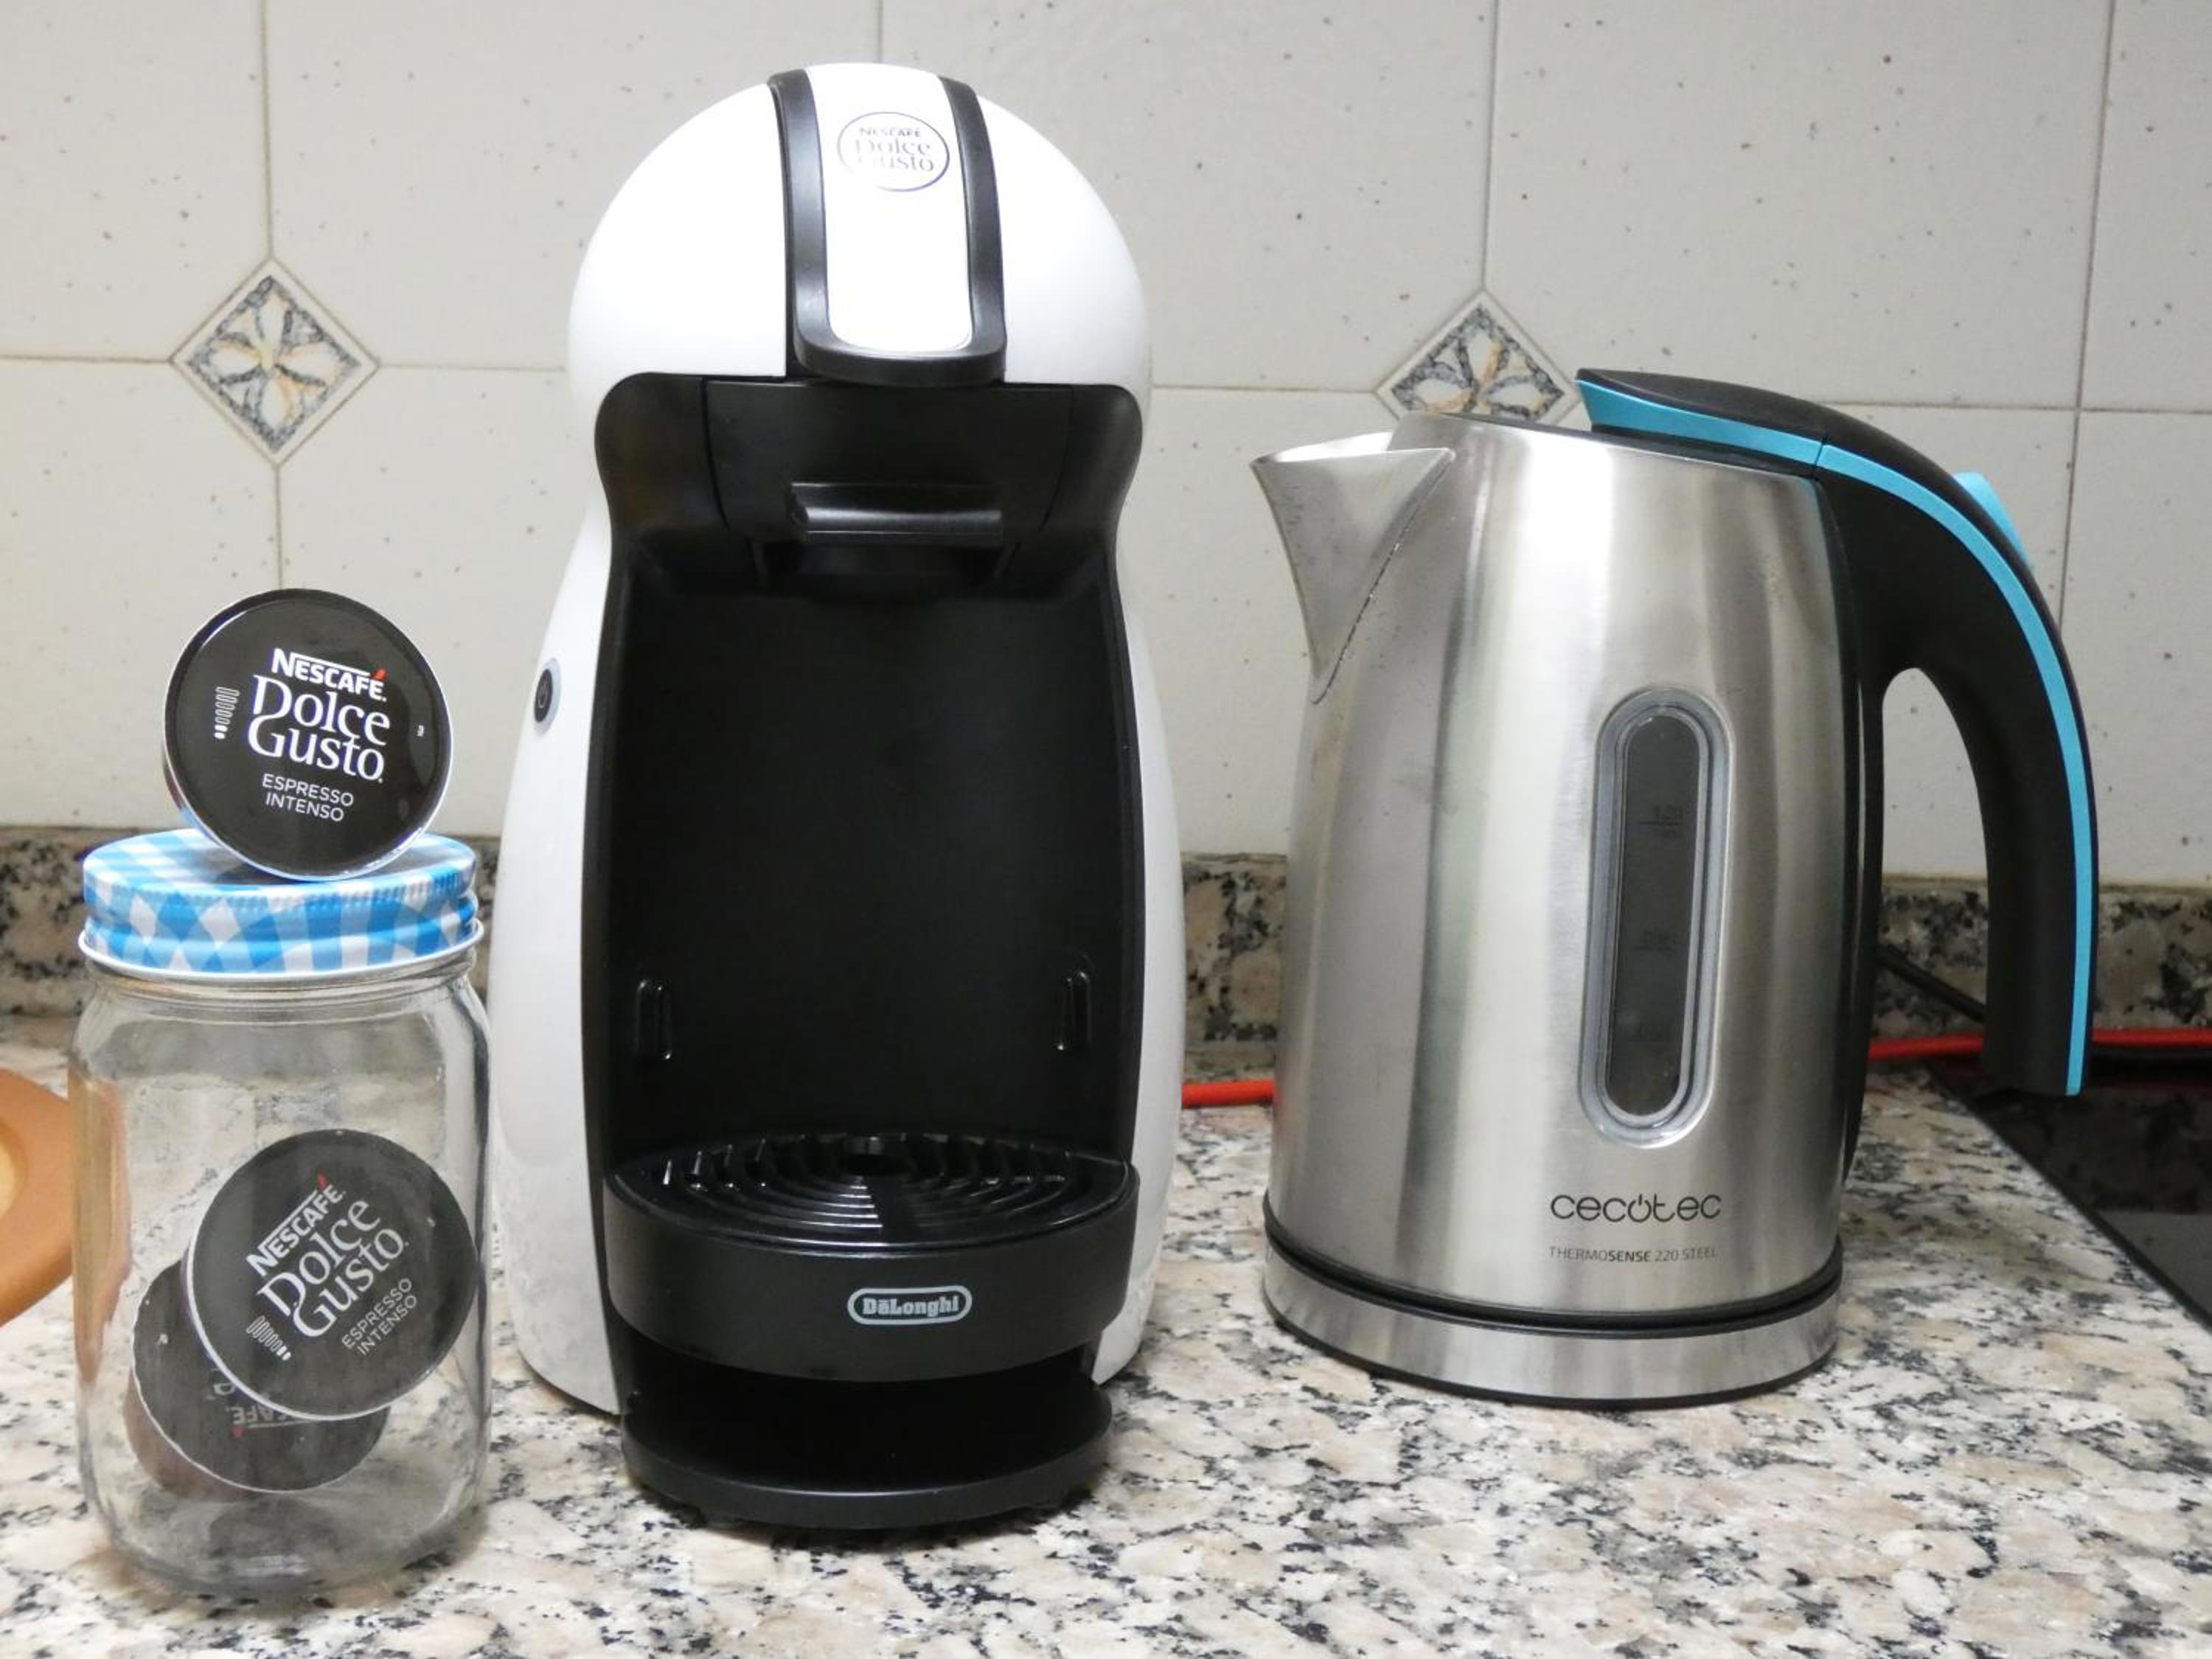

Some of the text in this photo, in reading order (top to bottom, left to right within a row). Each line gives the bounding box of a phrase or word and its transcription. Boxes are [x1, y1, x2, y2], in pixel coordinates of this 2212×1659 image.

[251, 674, 390, 745] Dolce
[248, 715, 383, 782] Gusto
[262, 773, 354, 807] ESPRESSO
[266, 792, 344, 822] INTENSO
[1551, 1194, 1721, 1222] cecotec
[257, 1200, 380, 1316] Dolce
[293, 1228, 405, 1338] Gusto
[1550, 1246, 1717, 1262] THERMOSENSE 220 STEEL
[342, 1279, 411, 1349] ESPRESSO
[357, 1295, 417, 1355] INTENSO
